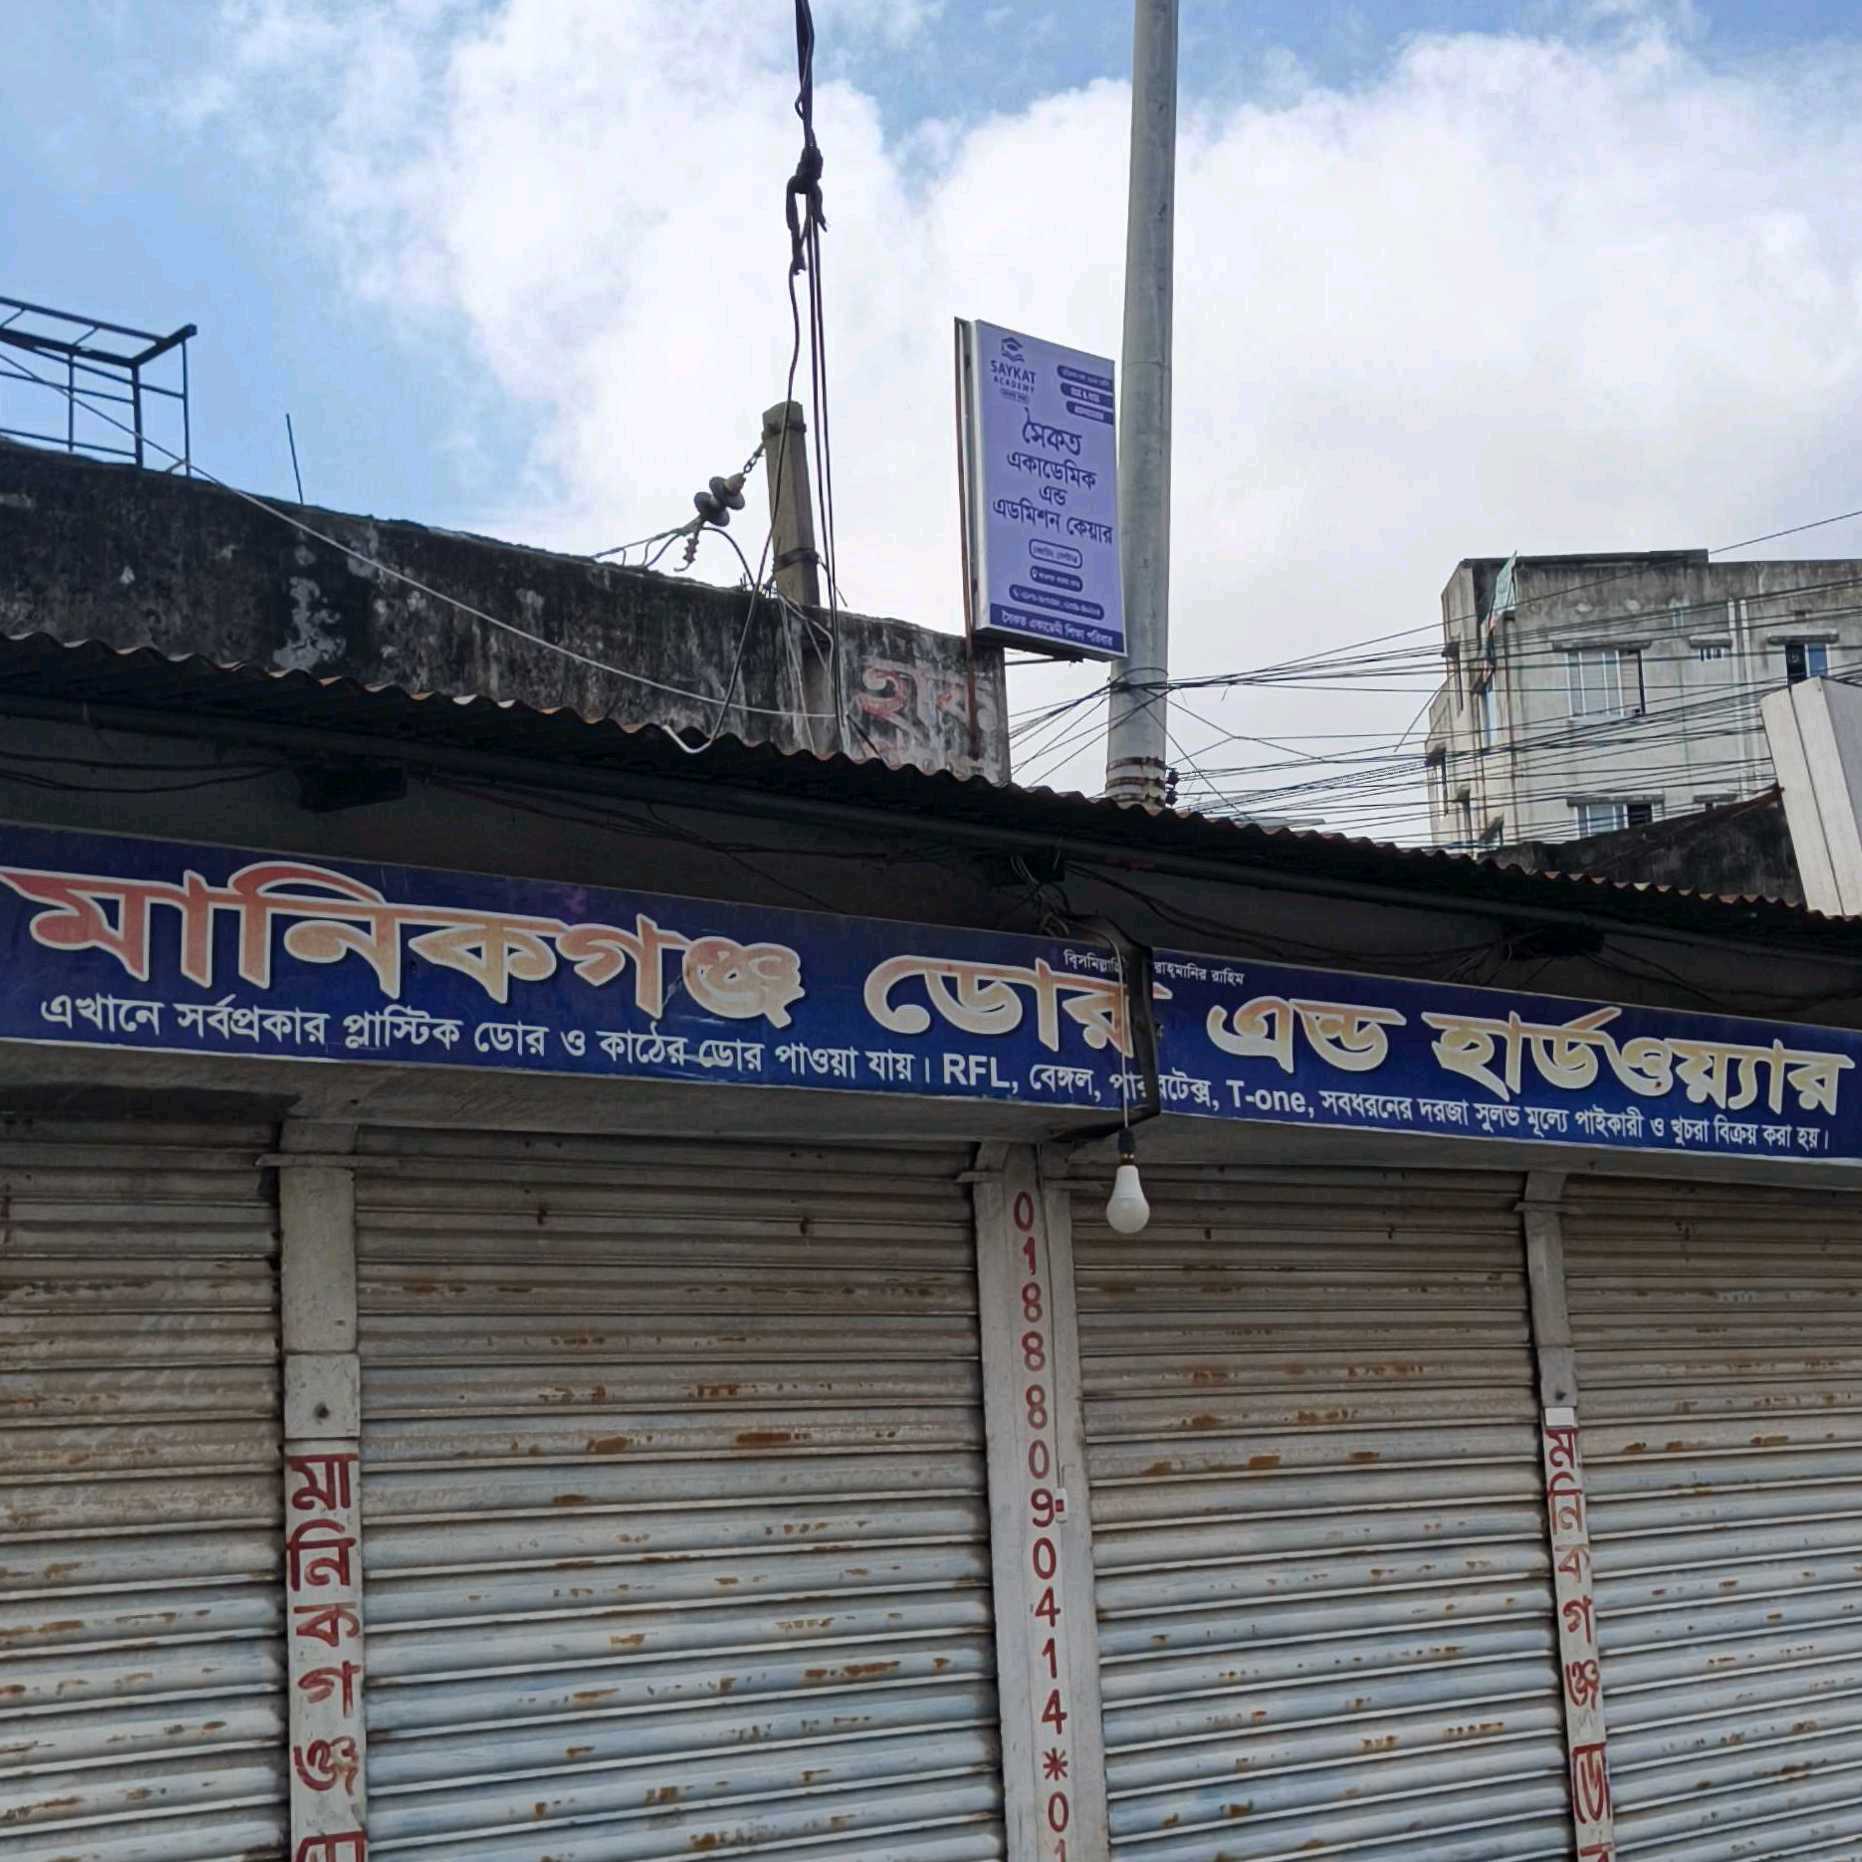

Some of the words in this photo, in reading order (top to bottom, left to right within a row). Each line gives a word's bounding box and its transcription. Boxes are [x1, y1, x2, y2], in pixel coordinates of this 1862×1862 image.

[991, 360, 1036, 384] SAYKAT
[1023, 407, 1082, 456] সৈকত
[1007, 451, 1097, 490] একাডেমিক
[1039, 485, 1068, 506] এন্ড
[993, 497, 1060, 534] এডমিশন
[1066, 517, 1114, 545] কেয়ার
[0, 861, 805, 1028] মানিকগঞ্জ
[864, 954, 1173, 1058] ডোর
[1206, 995, 1407, 1074] এন্ড
[1420, 1006, 1855, 1116] হার্ডওয়্যার
[40, 993, 165, 1036] এখানে
[172, 993, 331, 1045] সর্বপ্রকার
[343, 1004, 464, 1051] প্লাস্টিক
[474, 1019, 550, 1057] ডোর
[560, 1027, 586, 1057] ও
[596, 1021, 689, 1066] কাঠের
[698, 1037, 766, 1073] ডোর
[775, 1042, 859, 1080] পাওয়া
[942, 1052, 1018, 1095] RFL,
[1029, 1064, 1100, 1102] বেঙ্গল,
[1225, 1079, 1316, 1118] T-one,
[1318, 1090, 1413, 1121] সবধরনের
[1416, 1098, 1469, 1126] দরজা
[1473, 1102, 1520, 1133] সুলভ
[1524, 1106, 1570, 1138] মূল্যে
[1574, 1104, 1644, 1139] পাইকারী
[1650, 1117, 1665, 1137] ও
[1670, 1115, 1709, 1146] খুচরা
[1713, 1114, 1758, 1146] বিক্রয়
[1762, 1124, 1792, 1148] করা
